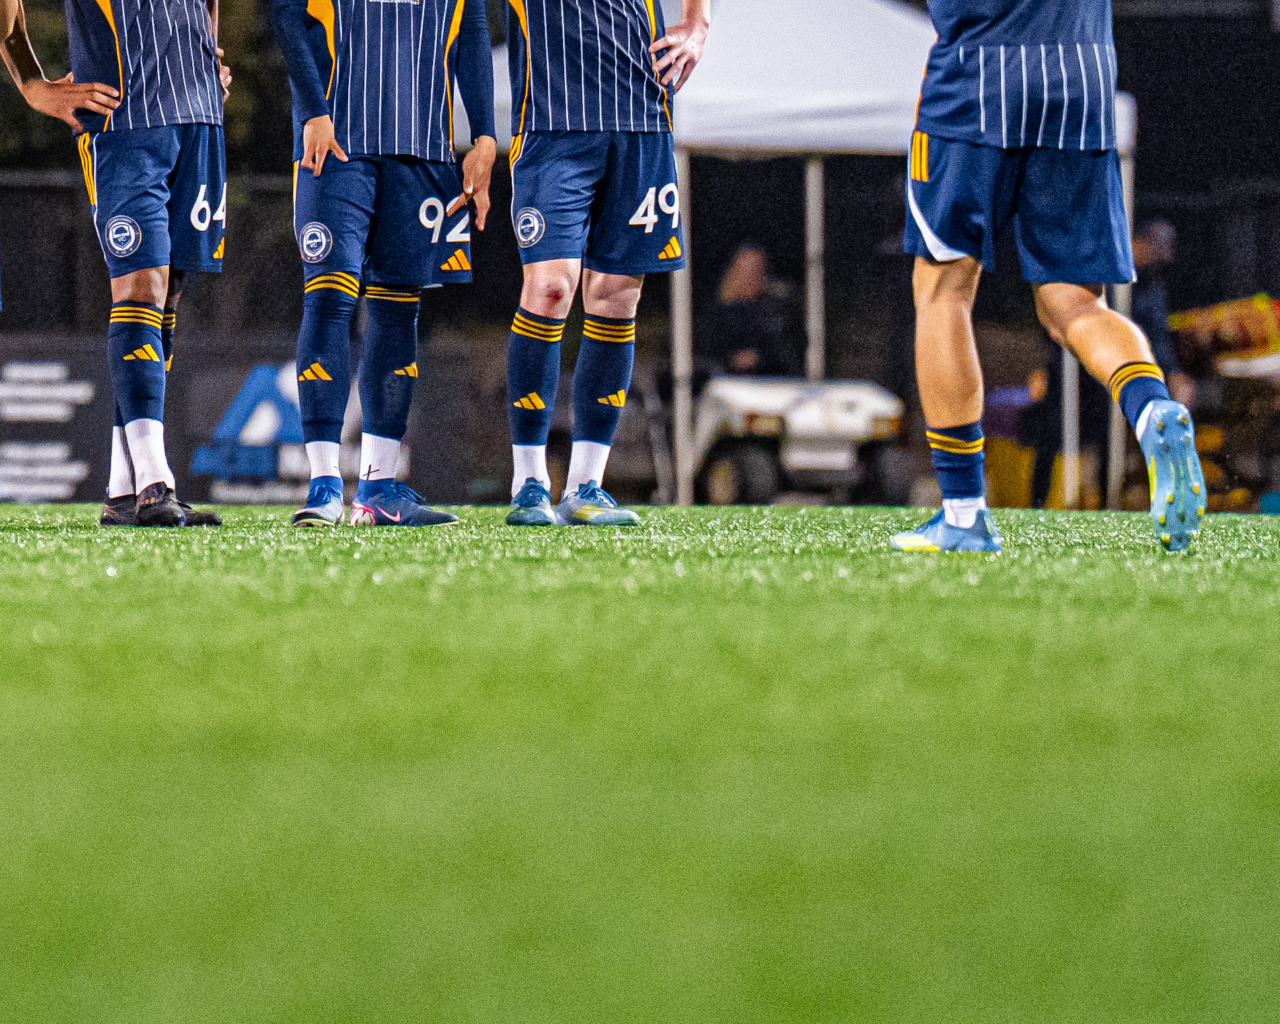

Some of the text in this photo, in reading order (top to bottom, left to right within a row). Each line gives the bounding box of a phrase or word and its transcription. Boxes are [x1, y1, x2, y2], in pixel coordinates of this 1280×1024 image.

[190, 182, 226, 231] 64
[419, 197, 470, 243] 92
[629, 183, 679, 233] 49
